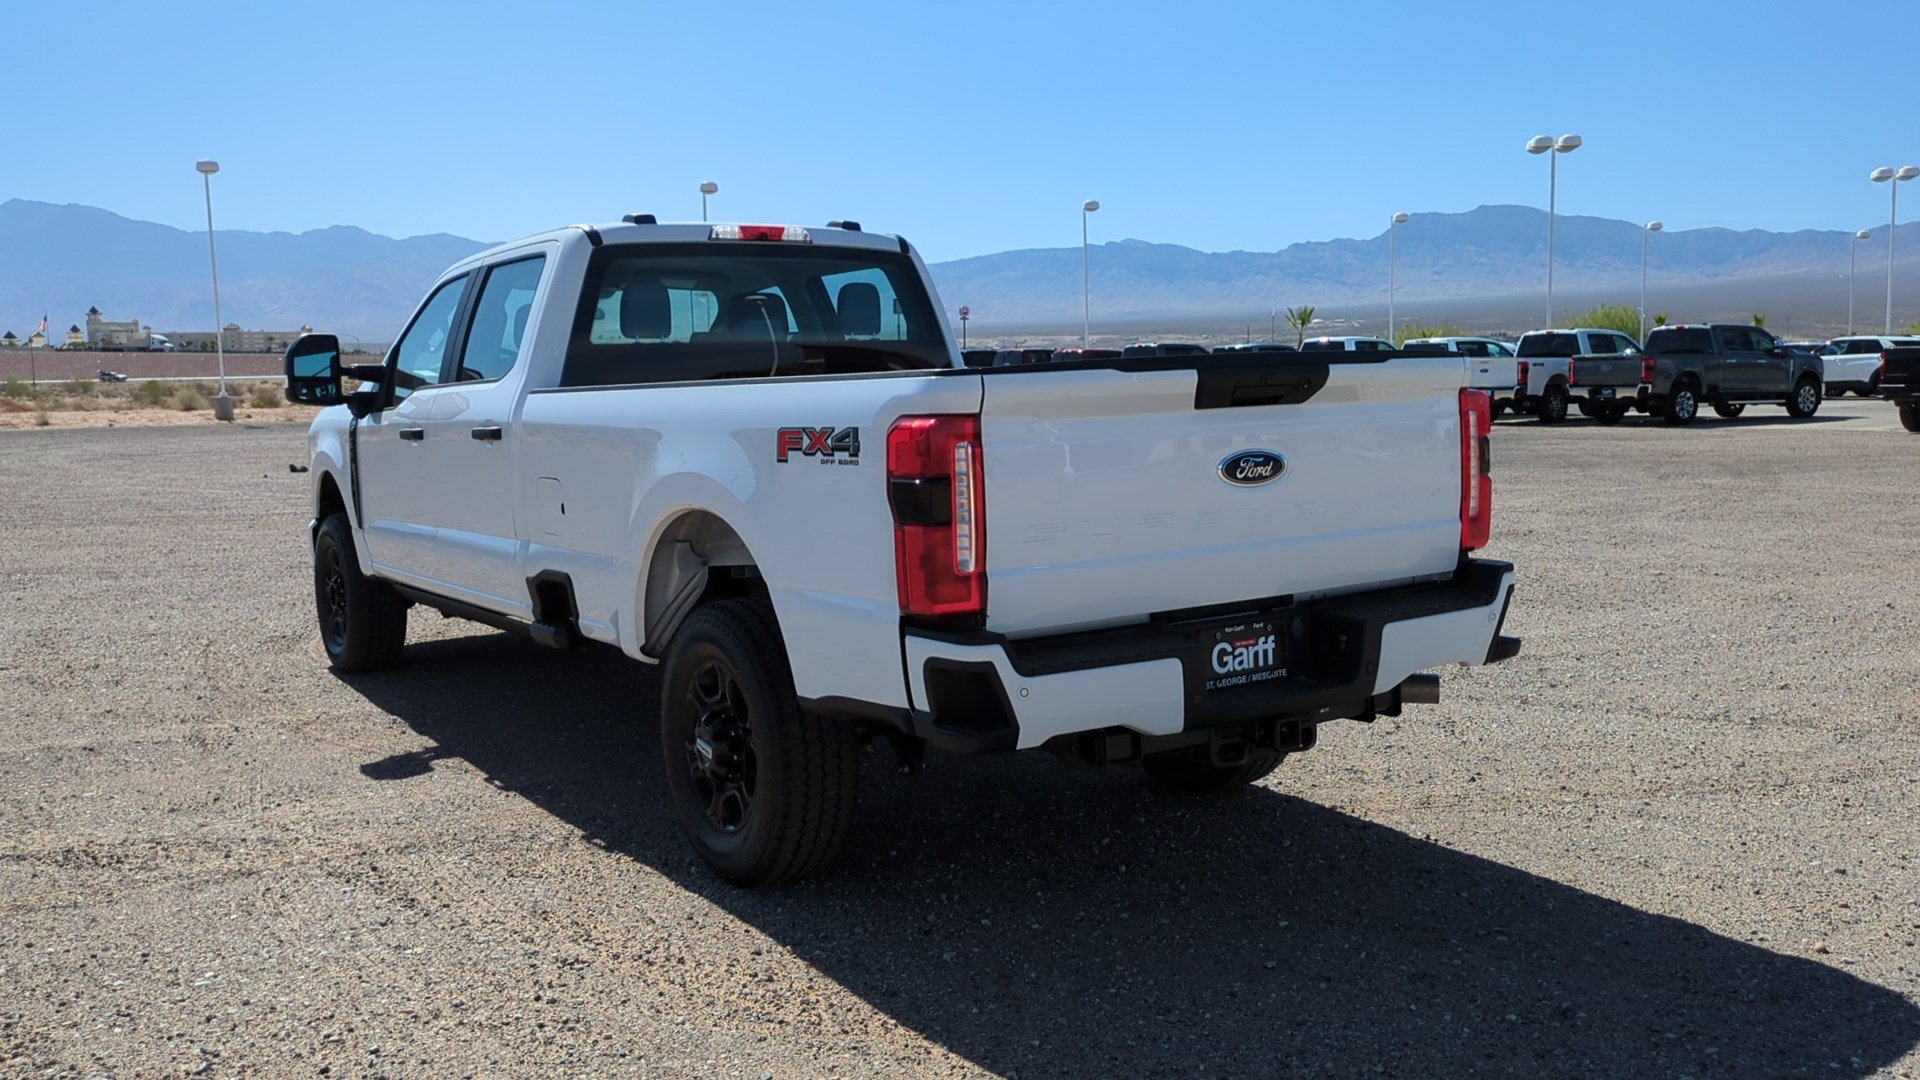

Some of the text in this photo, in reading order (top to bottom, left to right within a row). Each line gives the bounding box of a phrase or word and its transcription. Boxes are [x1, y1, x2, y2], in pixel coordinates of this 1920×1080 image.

[777, 427, 860, 463] FX4
[1236, 457, 1274, 479] Ford
[1212, 635, 1275, 674] Garff
[1217, 675, 1247, 687] GEORGE
[1252, 669, 1287, 681] MESQUITE
